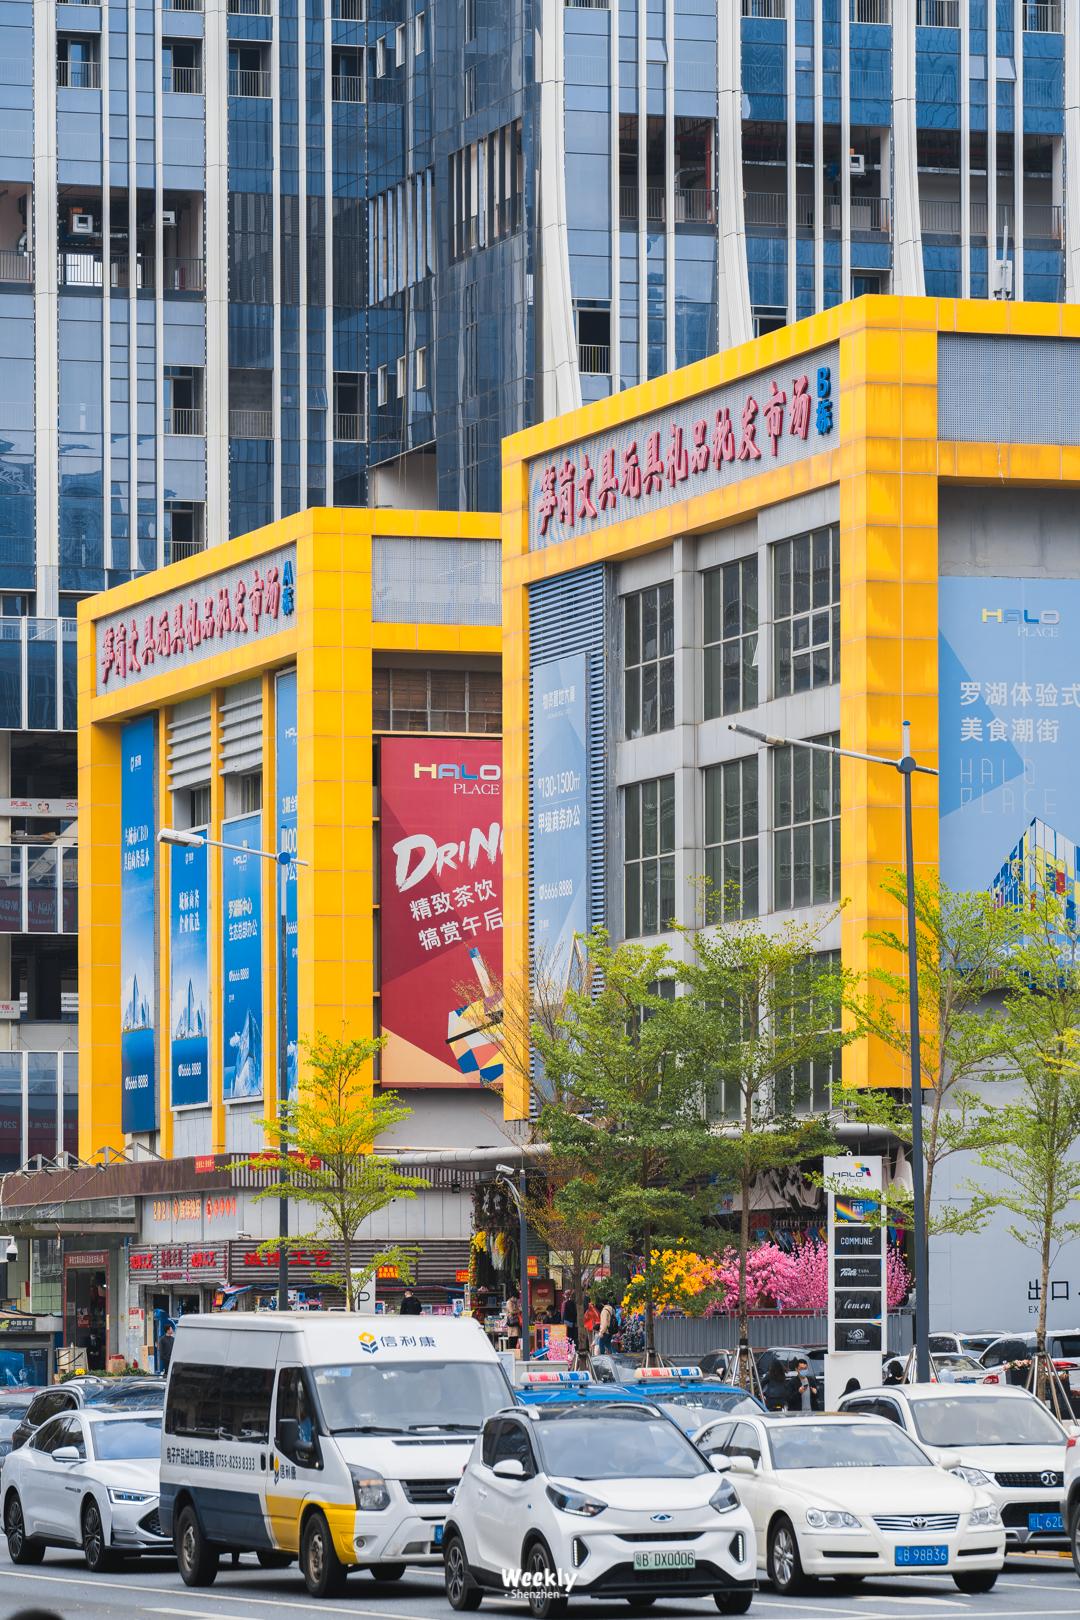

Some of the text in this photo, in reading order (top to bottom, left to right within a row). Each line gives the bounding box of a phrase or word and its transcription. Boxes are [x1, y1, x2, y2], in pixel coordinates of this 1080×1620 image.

[538, 375, 811, 535] 笋岗文具玩具礼品批发市场
[101, 567, 280, 684] 笋岗文具玩具礼品批发市场
[982, 608, 1060, 624] HALO
[1017, 627, 1059, 637] PLACE
[960, 682, 1080, 707] 罗湖体验式
[960, 717, 1060, 743] 美食潮街
[413, 763, 501, 780] HALO
[453, 783, 500, 795] PLACE
[392, 822, 503, 893] DRIN
[409, 878, 497, 922] 精致茶饮
[418, 908, 503, 951] 犒赏午后
[840, 1237, 873, 1245] COMMUNE
[1028, 1279, 1069, 1301] 出口
[380, 1336, 437, 1348] 信利康
[166, 1447, 215, 1468] 电子产品进出口服务商
[280, 1464, 297, 1480] 信利康
[654, 1552, 694, 1567] DX0006
